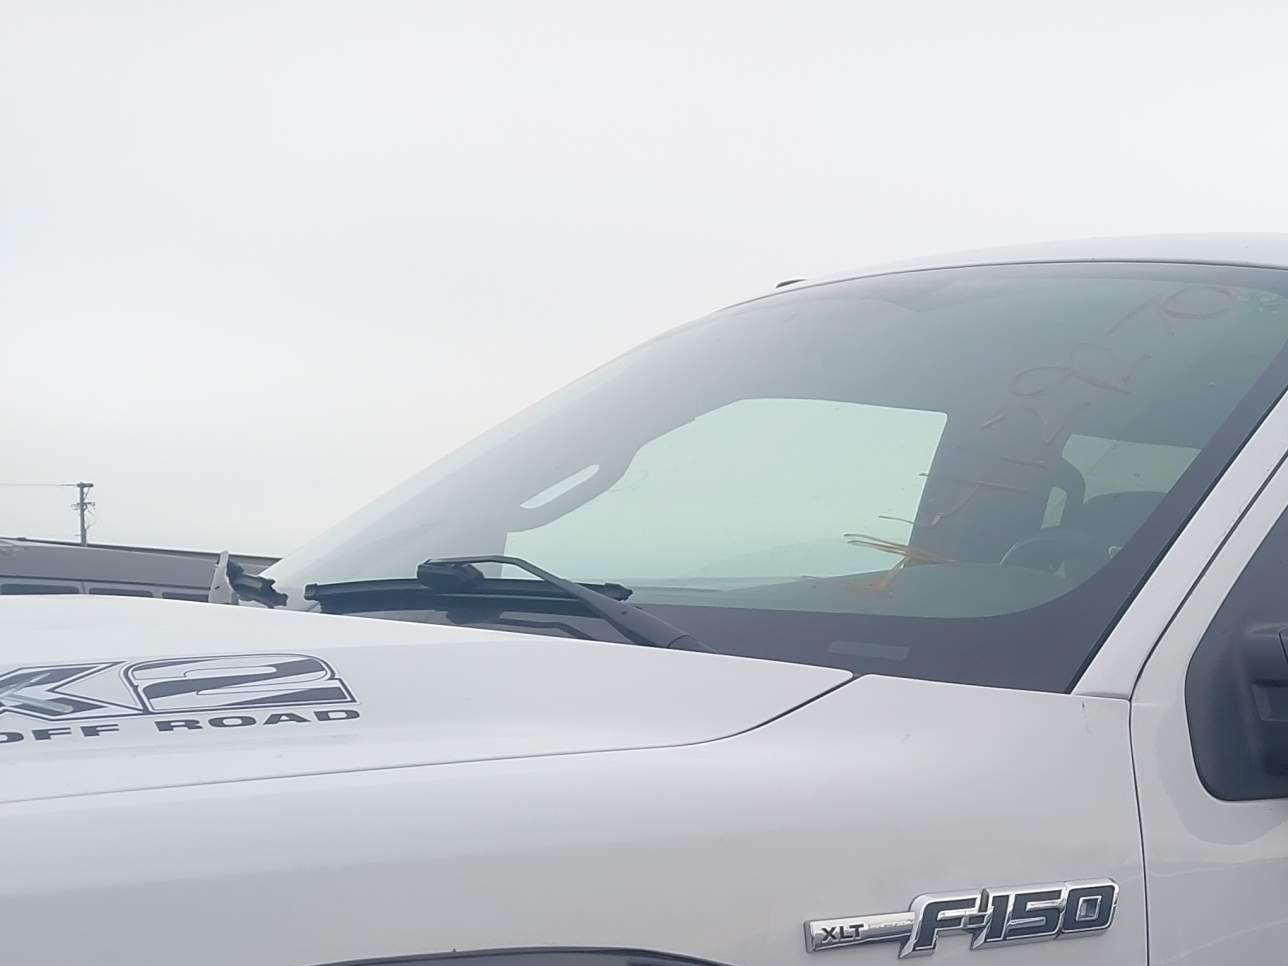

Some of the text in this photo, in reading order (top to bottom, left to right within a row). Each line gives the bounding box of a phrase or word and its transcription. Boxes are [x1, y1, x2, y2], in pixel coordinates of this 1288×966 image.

[154, 709, 361, 732] ROAD
[820, 879, 1120, 960] XLT F-150
